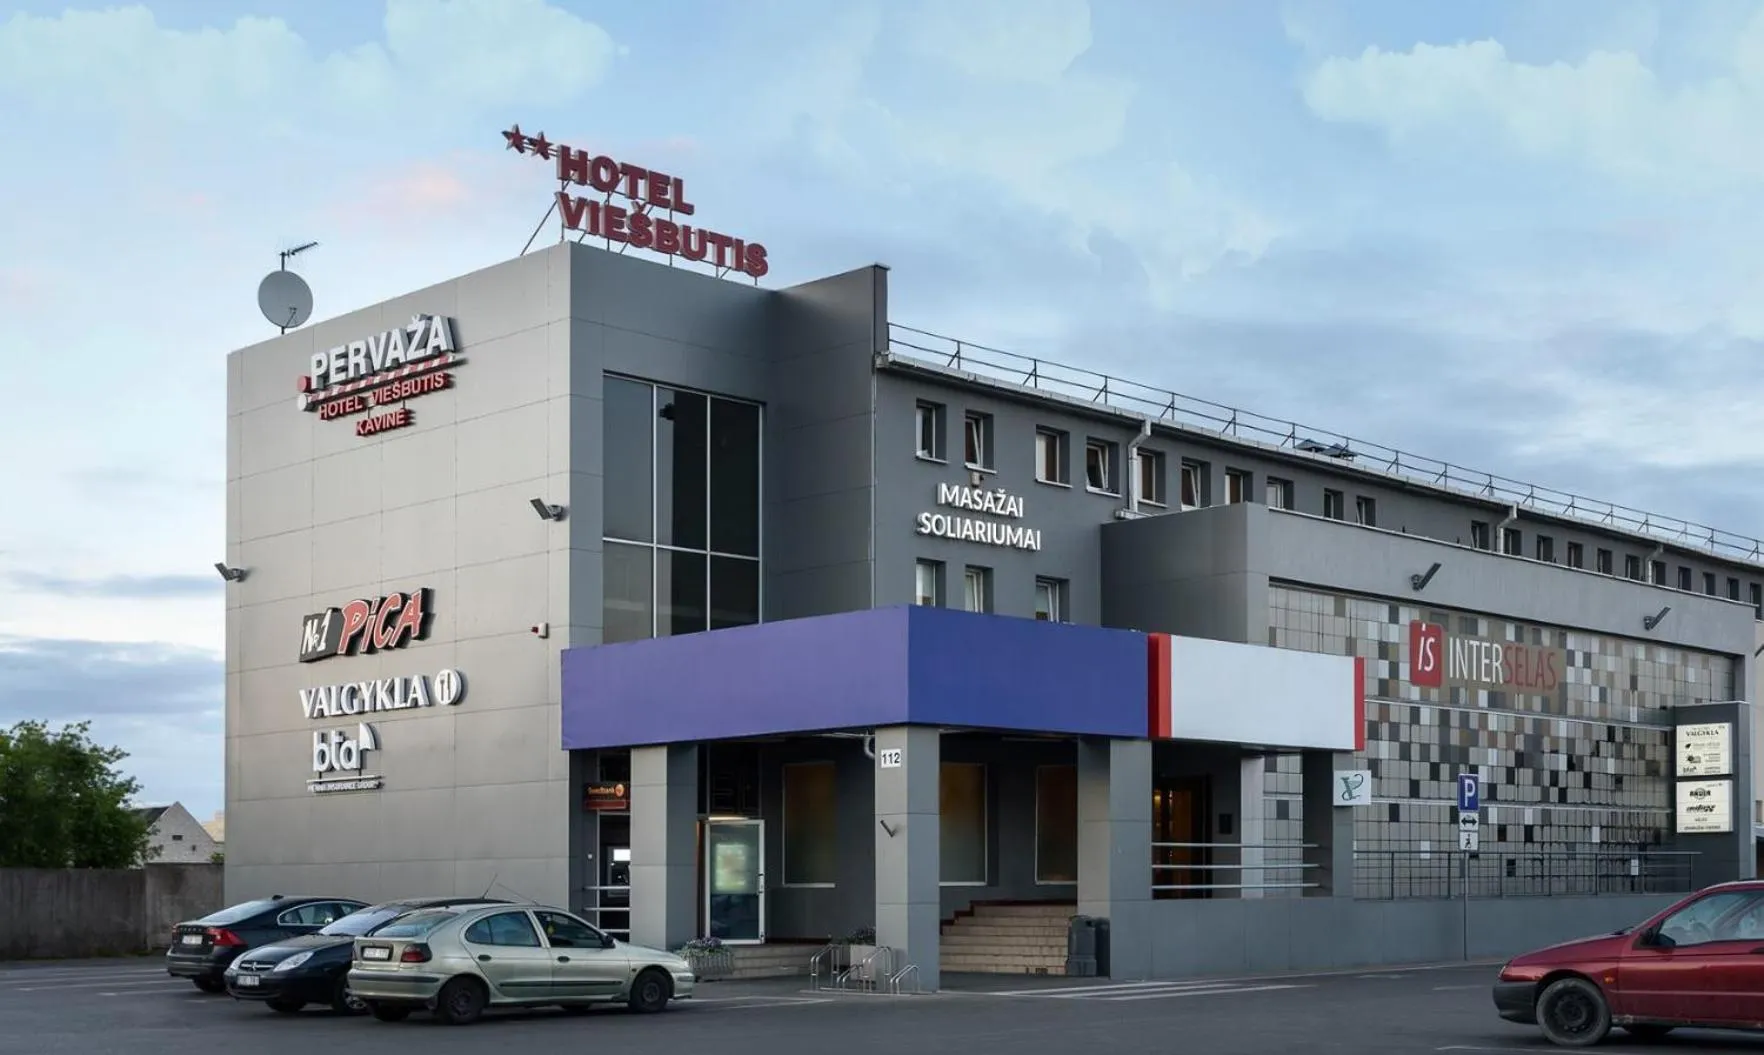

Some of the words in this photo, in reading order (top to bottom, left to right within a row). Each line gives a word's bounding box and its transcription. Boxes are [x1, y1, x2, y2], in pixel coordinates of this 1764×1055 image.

[556, 144, 694, 215] HOTEL
[555, 191, 769, 277] VIEŠBUTIS
[310, 314, 457, 389] PERVAŽA
[319, 395, 364, 419] HOTEL
[937, 482, 1024, 518] MASAŽAI
[917, 511, 1041, 550] SOLIARIUMAI
[1449, 637, 1558, 691] INTERSELAS
[299, 675, 431, 718] VALGYKLA
[882, 752, 900, 765] 112
[1463, 779, 1476, 807] P
